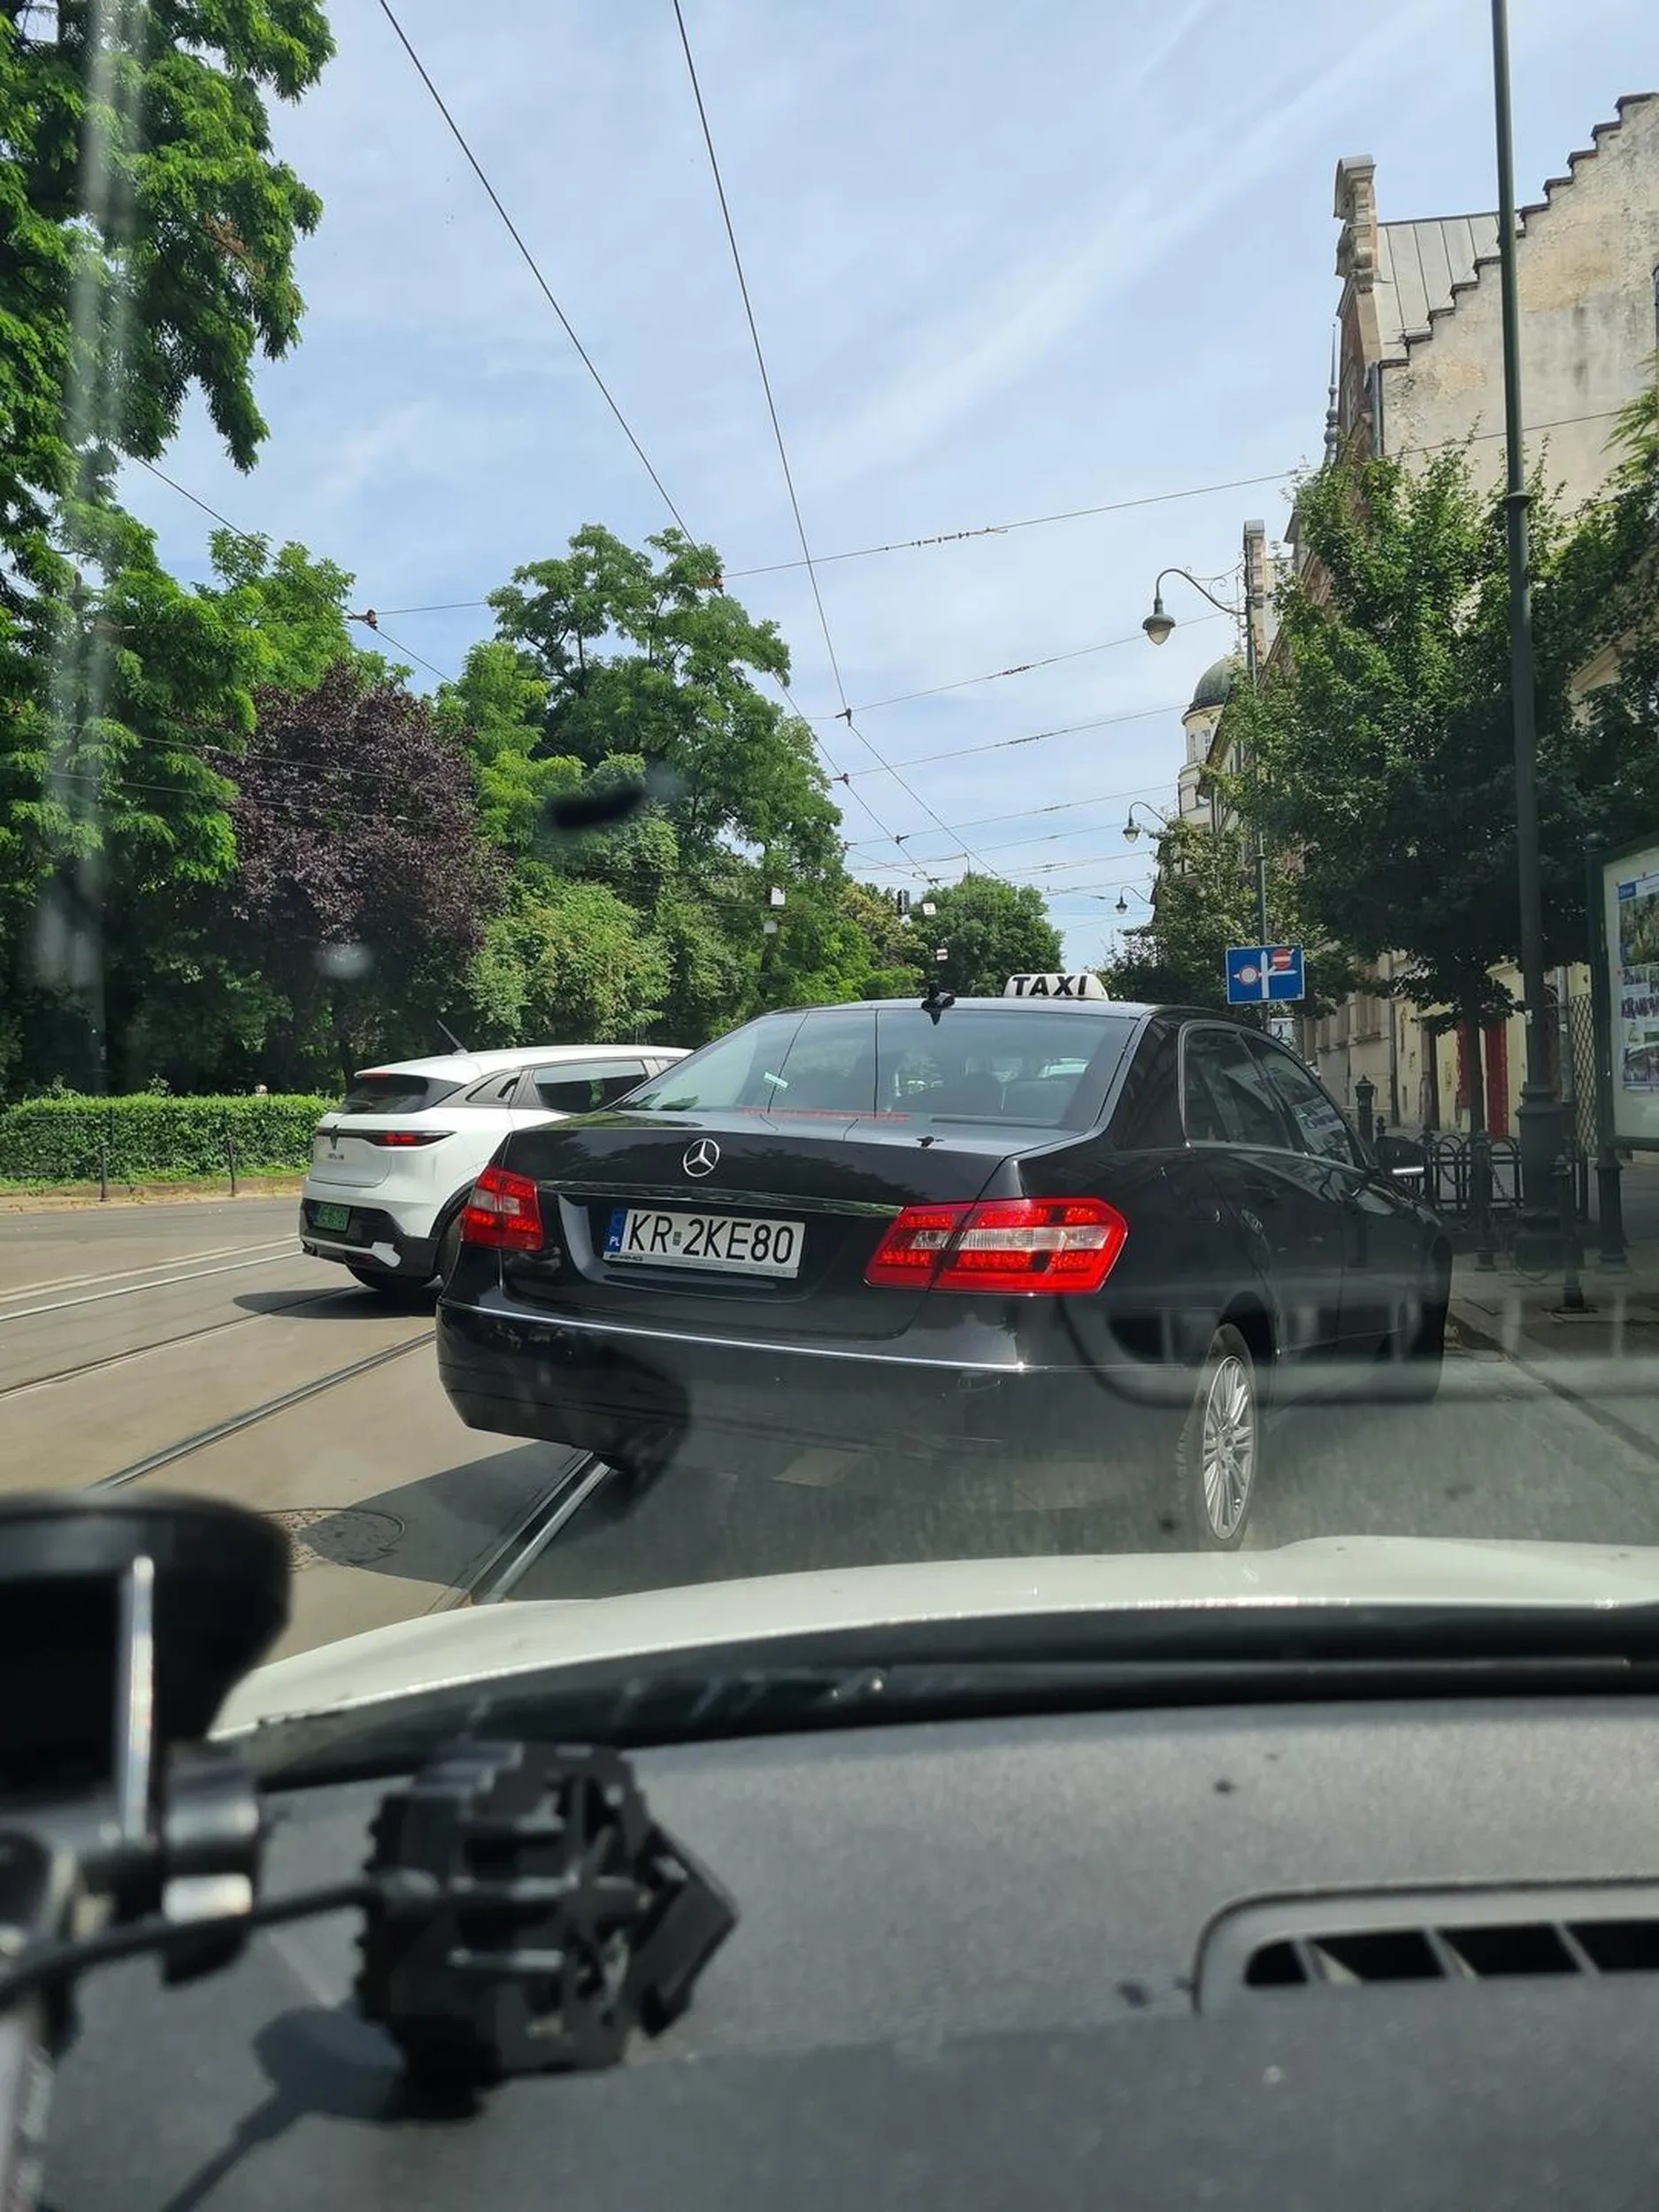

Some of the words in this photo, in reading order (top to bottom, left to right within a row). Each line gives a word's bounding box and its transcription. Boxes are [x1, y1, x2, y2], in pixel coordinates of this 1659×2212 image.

[1012, 975, 1087, 996] TAXI
[609, 1235, 620, 1247] PL
[627, 1213, 673, 1254] KR
[682, 1217, 795, 1264] 2KE80
